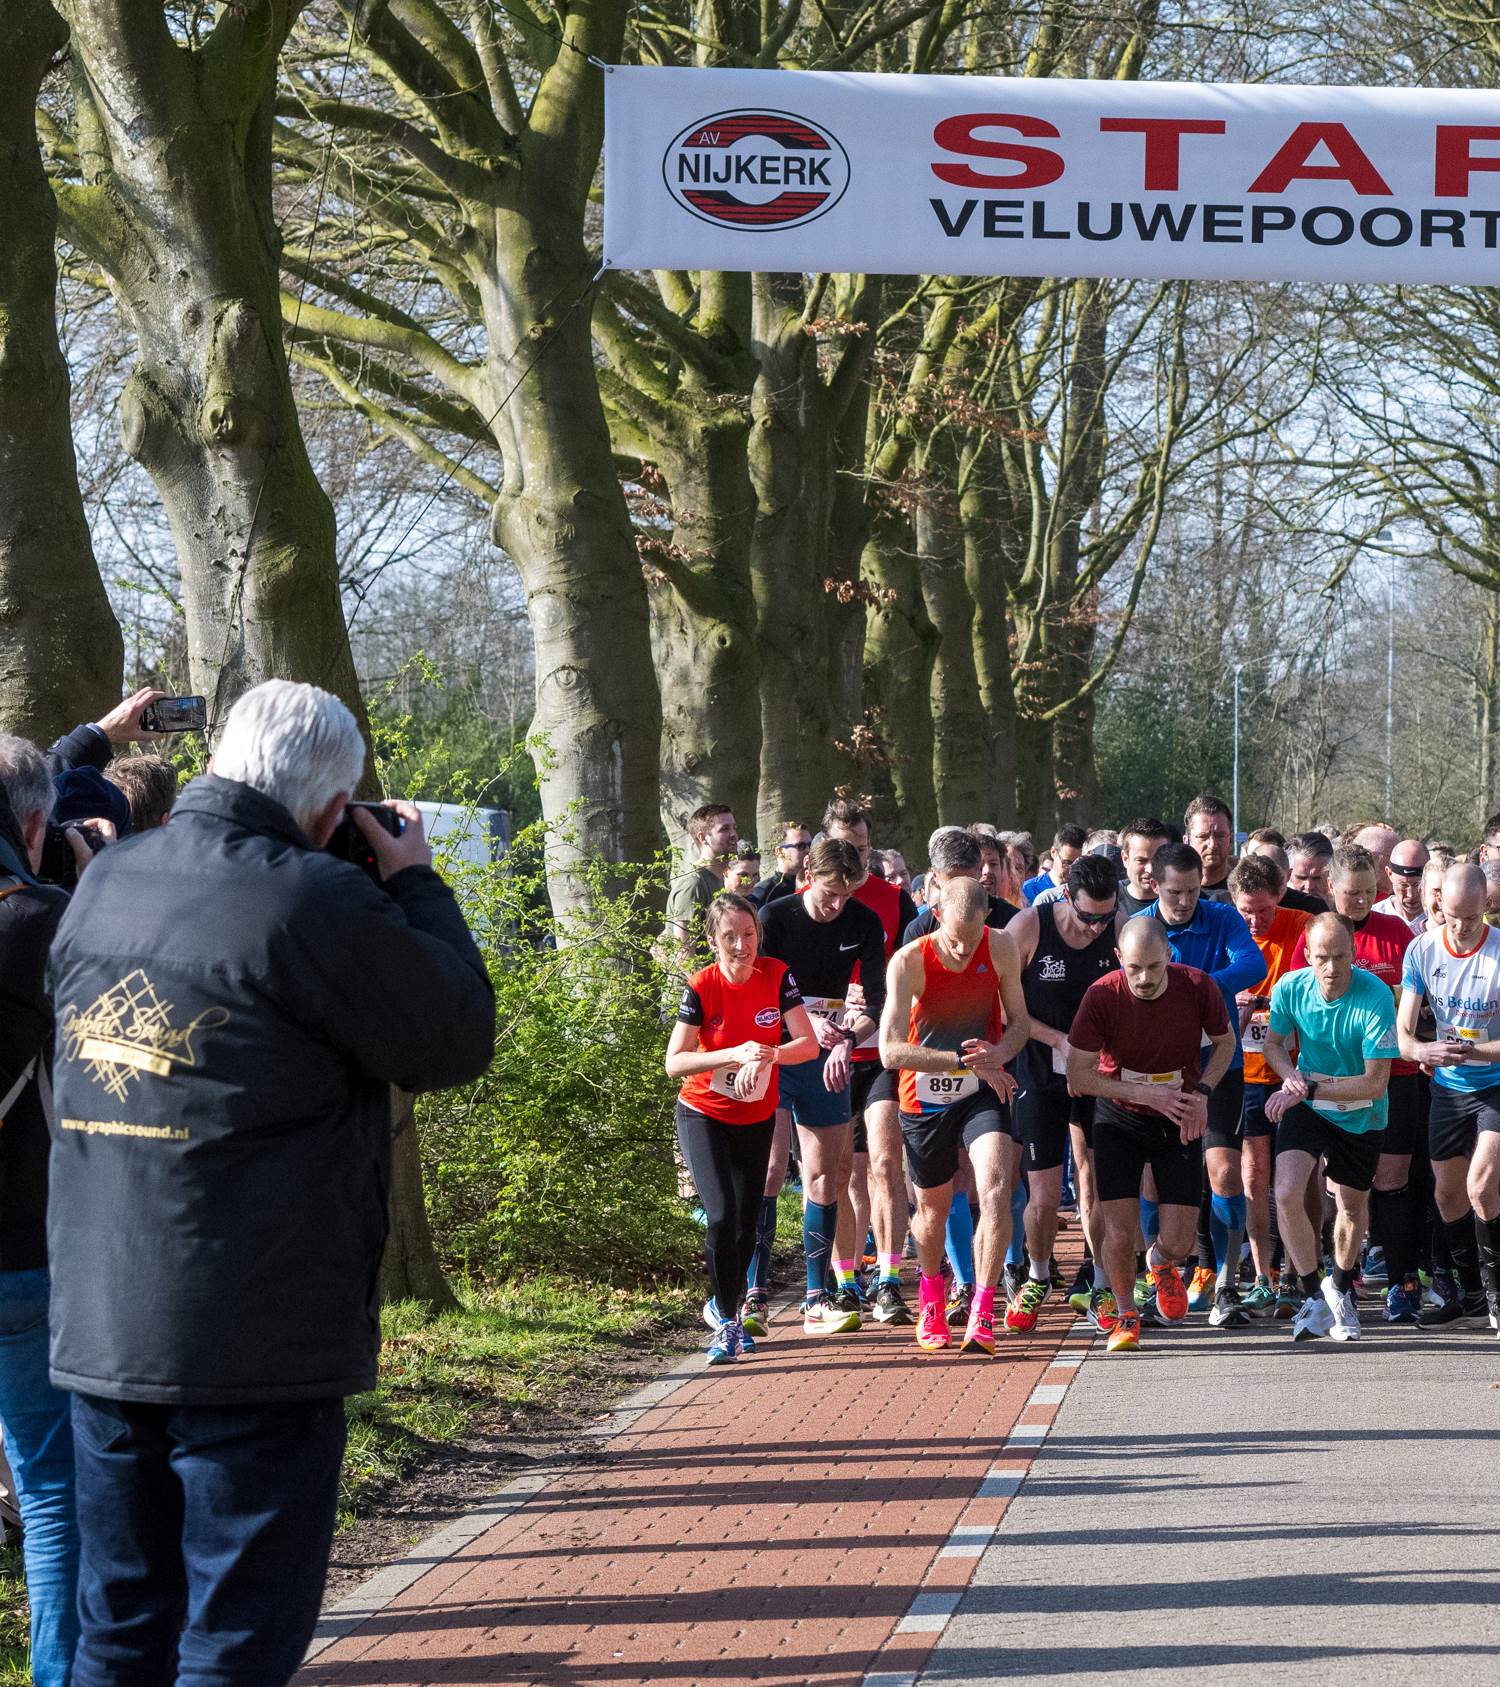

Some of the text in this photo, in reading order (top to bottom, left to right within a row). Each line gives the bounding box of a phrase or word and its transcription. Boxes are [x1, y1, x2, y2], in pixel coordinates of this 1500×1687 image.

[699, 131, 720, 145] AV
[677, 154, 831, 187] NIJKERK
[1448, 996, 1499, 1012] Bedden
[929, 1077, 964, 1092] 897
[61, 1118, 190, 1141] www.graphicsound.nl
